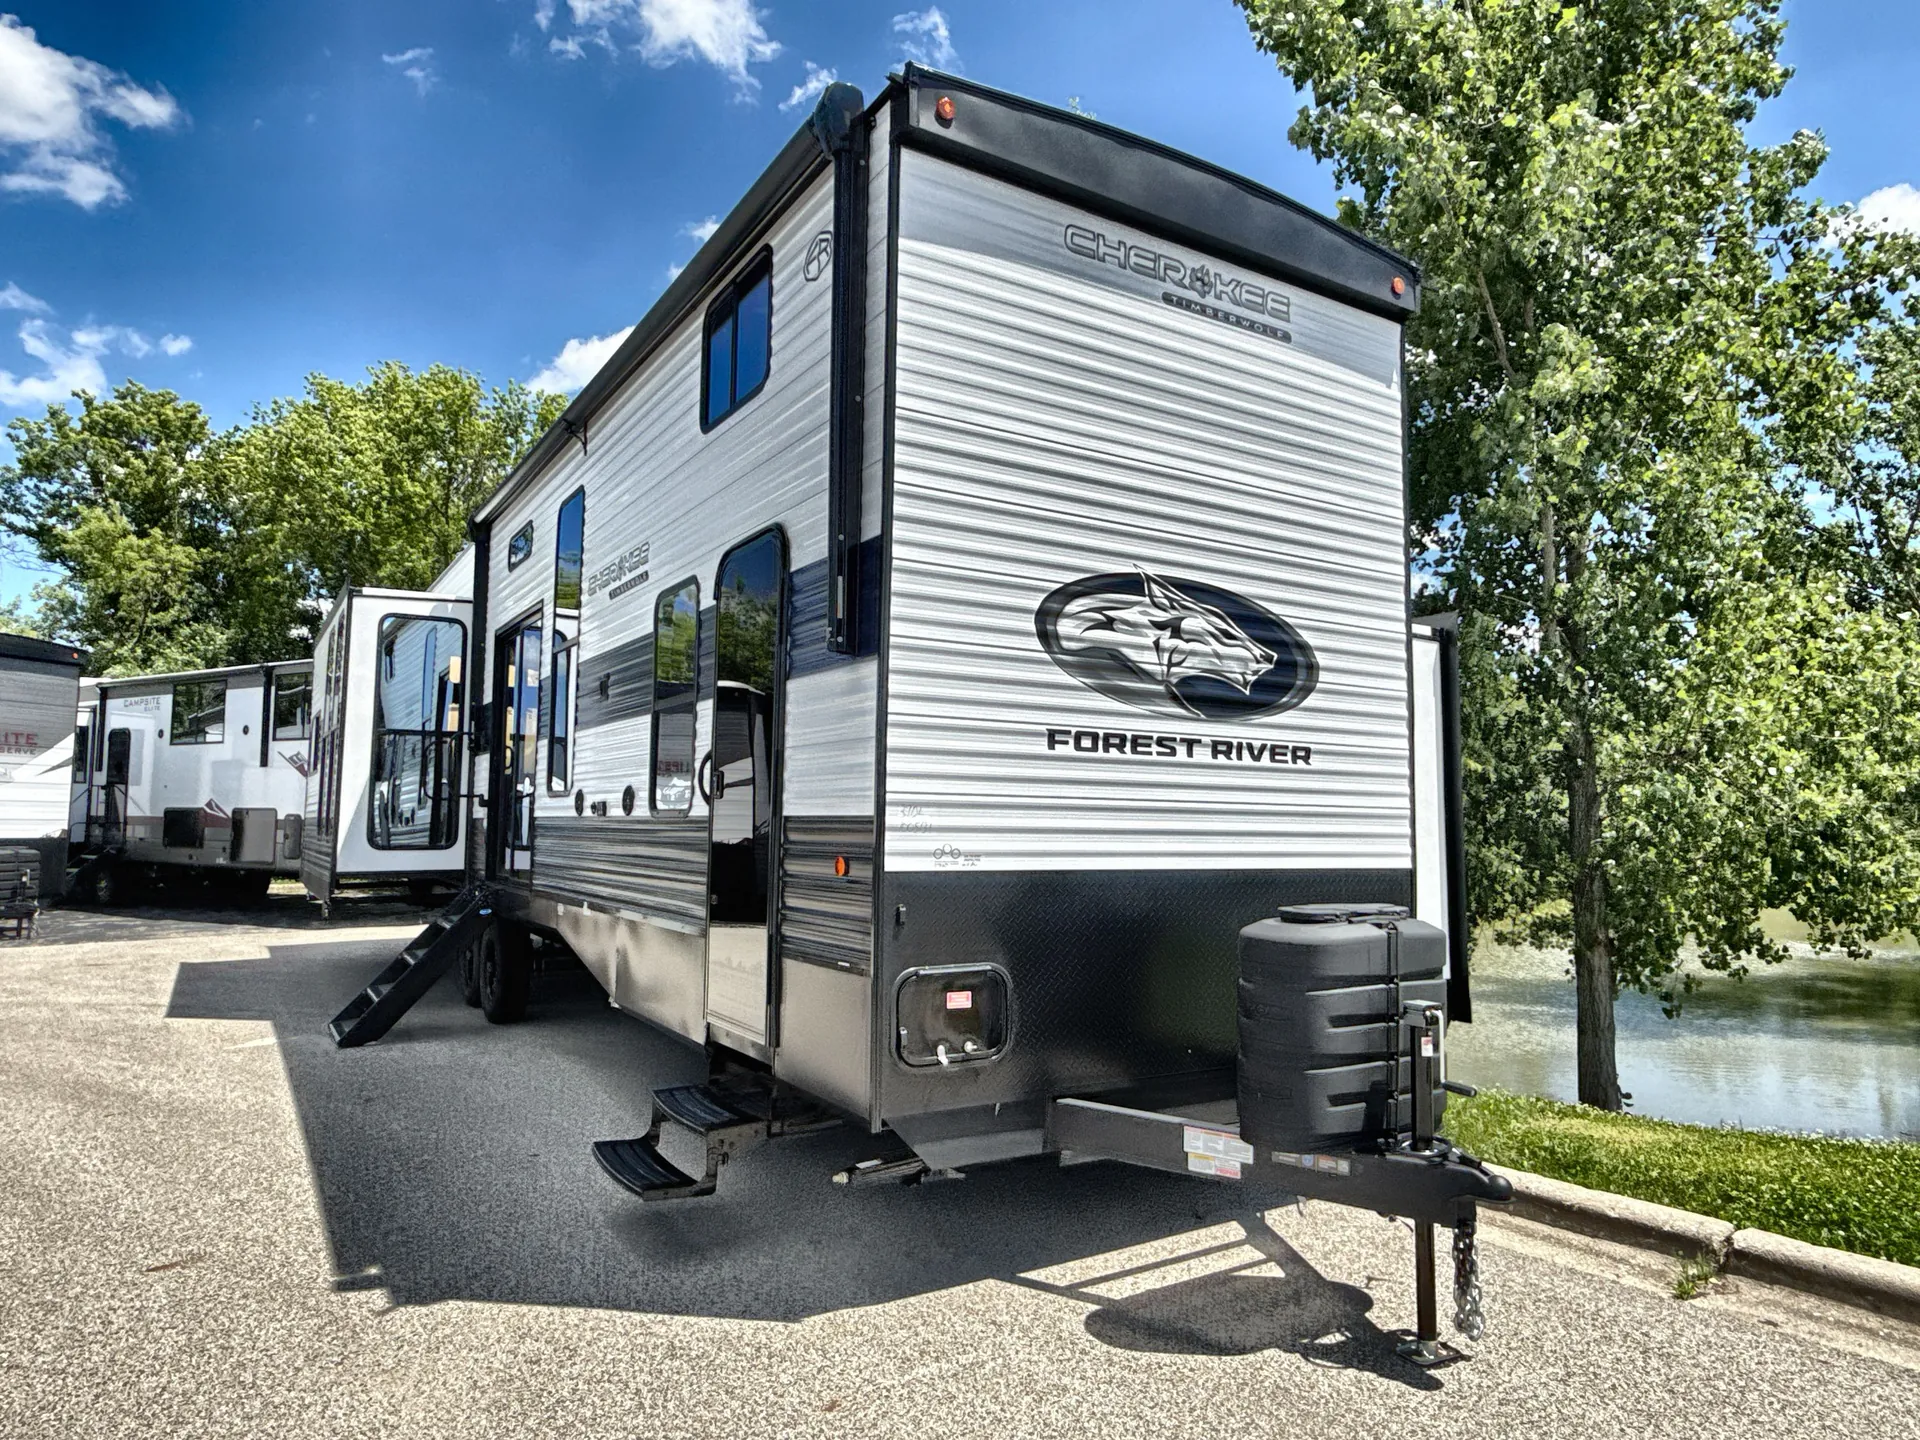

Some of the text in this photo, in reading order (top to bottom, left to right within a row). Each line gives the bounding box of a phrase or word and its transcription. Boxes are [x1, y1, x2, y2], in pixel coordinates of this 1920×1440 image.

[1170, 295, 1285, 338] TIMBERWOLF
[123, 696, 161, 708] CAMPSITE
[1047, 729, 1312, 766] FOREST RIVER
